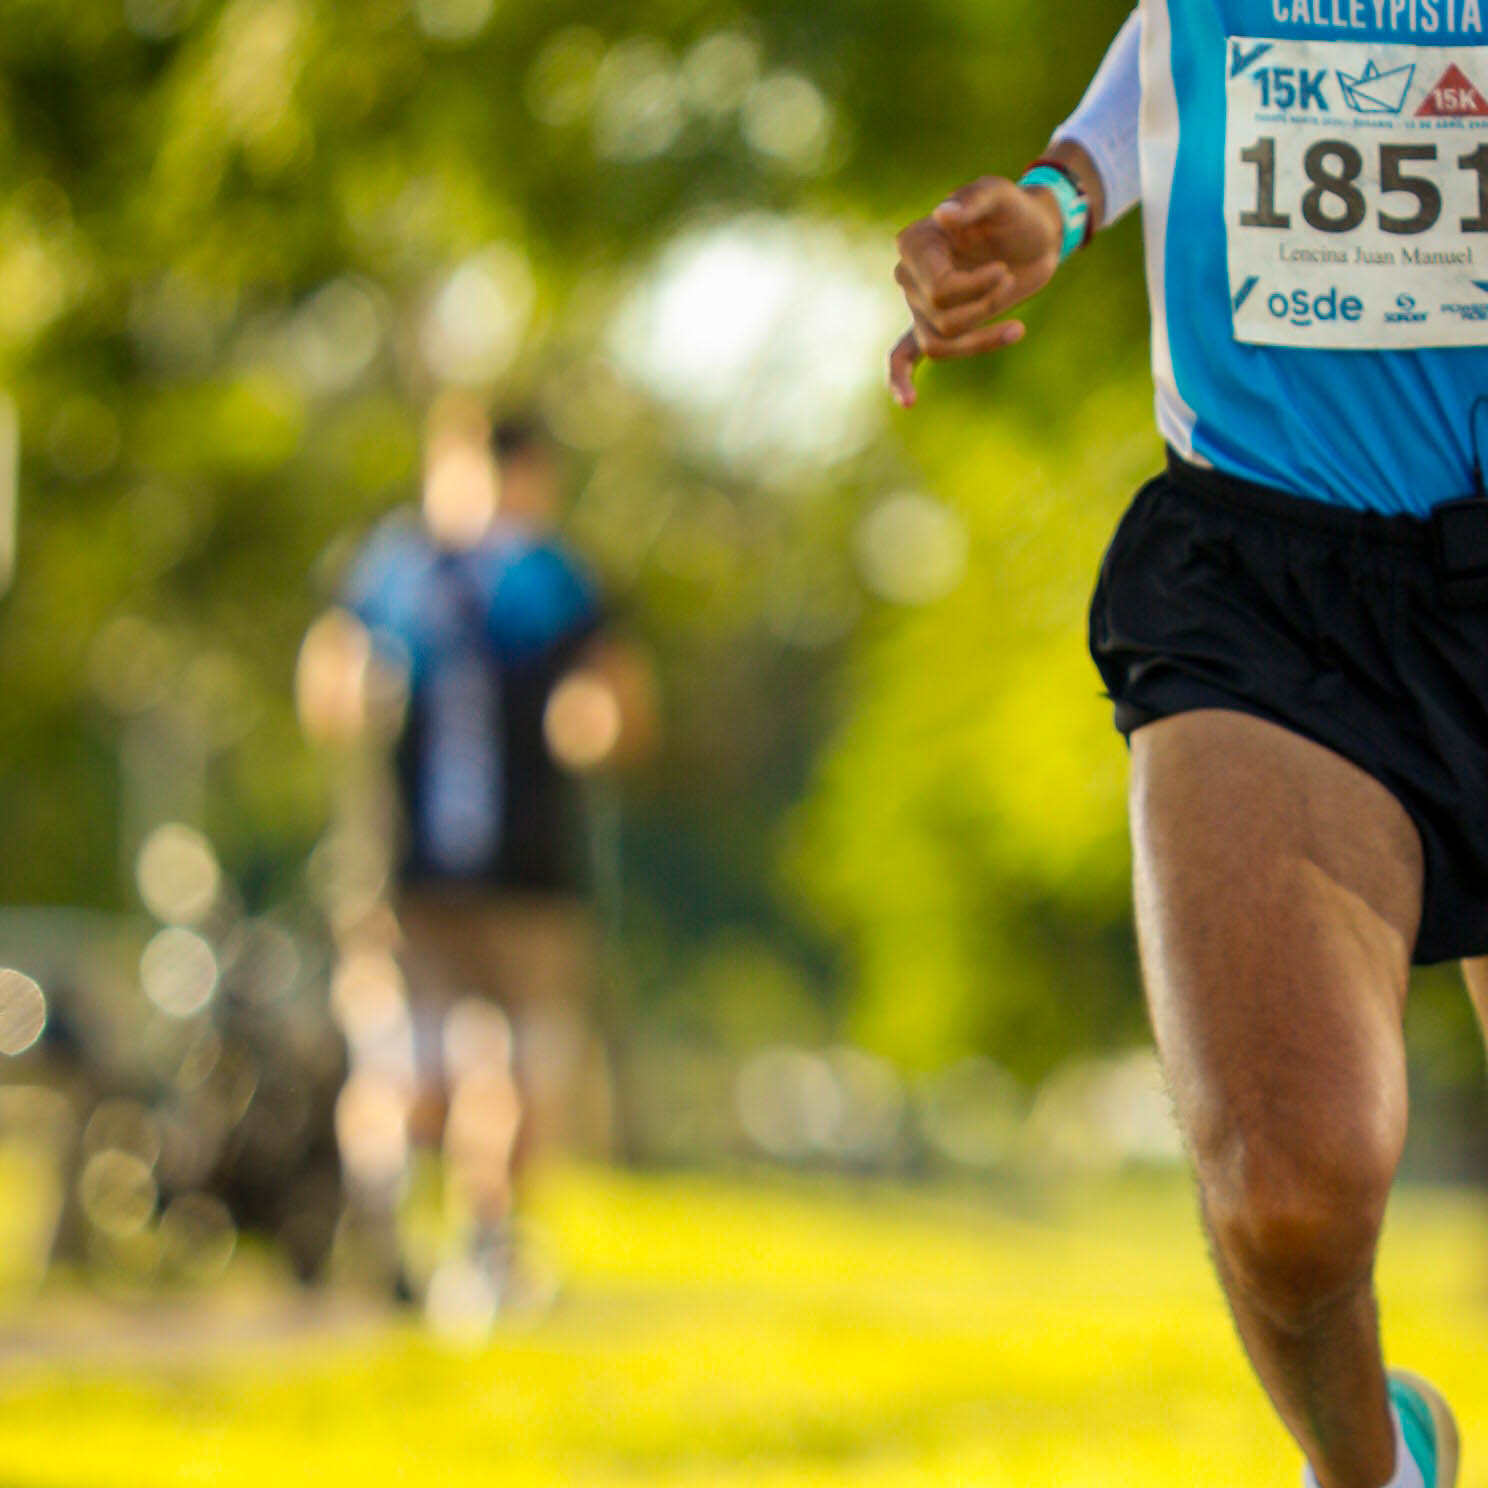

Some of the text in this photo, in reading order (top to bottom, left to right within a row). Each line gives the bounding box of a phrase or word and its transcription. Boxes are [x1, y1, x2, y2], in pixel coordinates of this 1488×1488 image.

[1253, 67, 1329, 112] 15K
[1433, 88, 1480, 112] 15K
[1353, 245, 1395, 266] Juan
[1401, 245, 1473, 266] Manuel
[1267, 286, 1364, 323] osde
